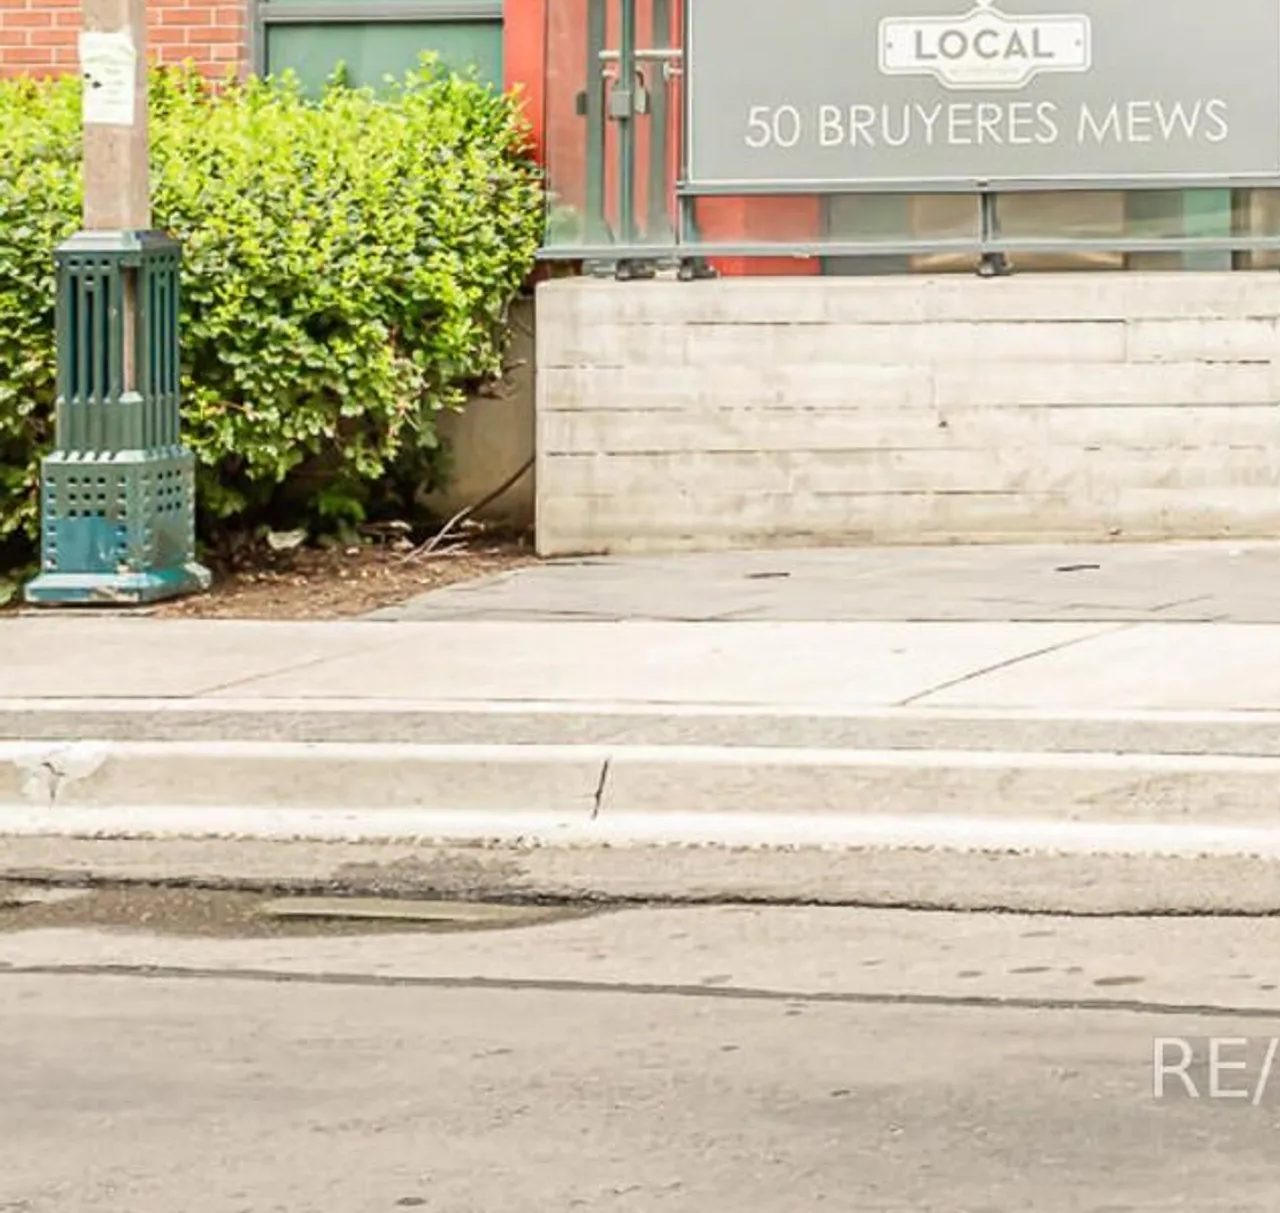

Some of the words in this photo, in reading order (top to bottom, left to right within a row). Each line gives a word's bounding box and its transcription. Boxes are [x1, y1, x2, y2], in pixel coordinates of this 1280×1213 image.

[914, 27, 1056, 60] LOCAL
[744, 104, 801, 148] 50
[818, 100, 1060, 147] BRUYERES
[1078, 98, 1229, 145] MEWS
